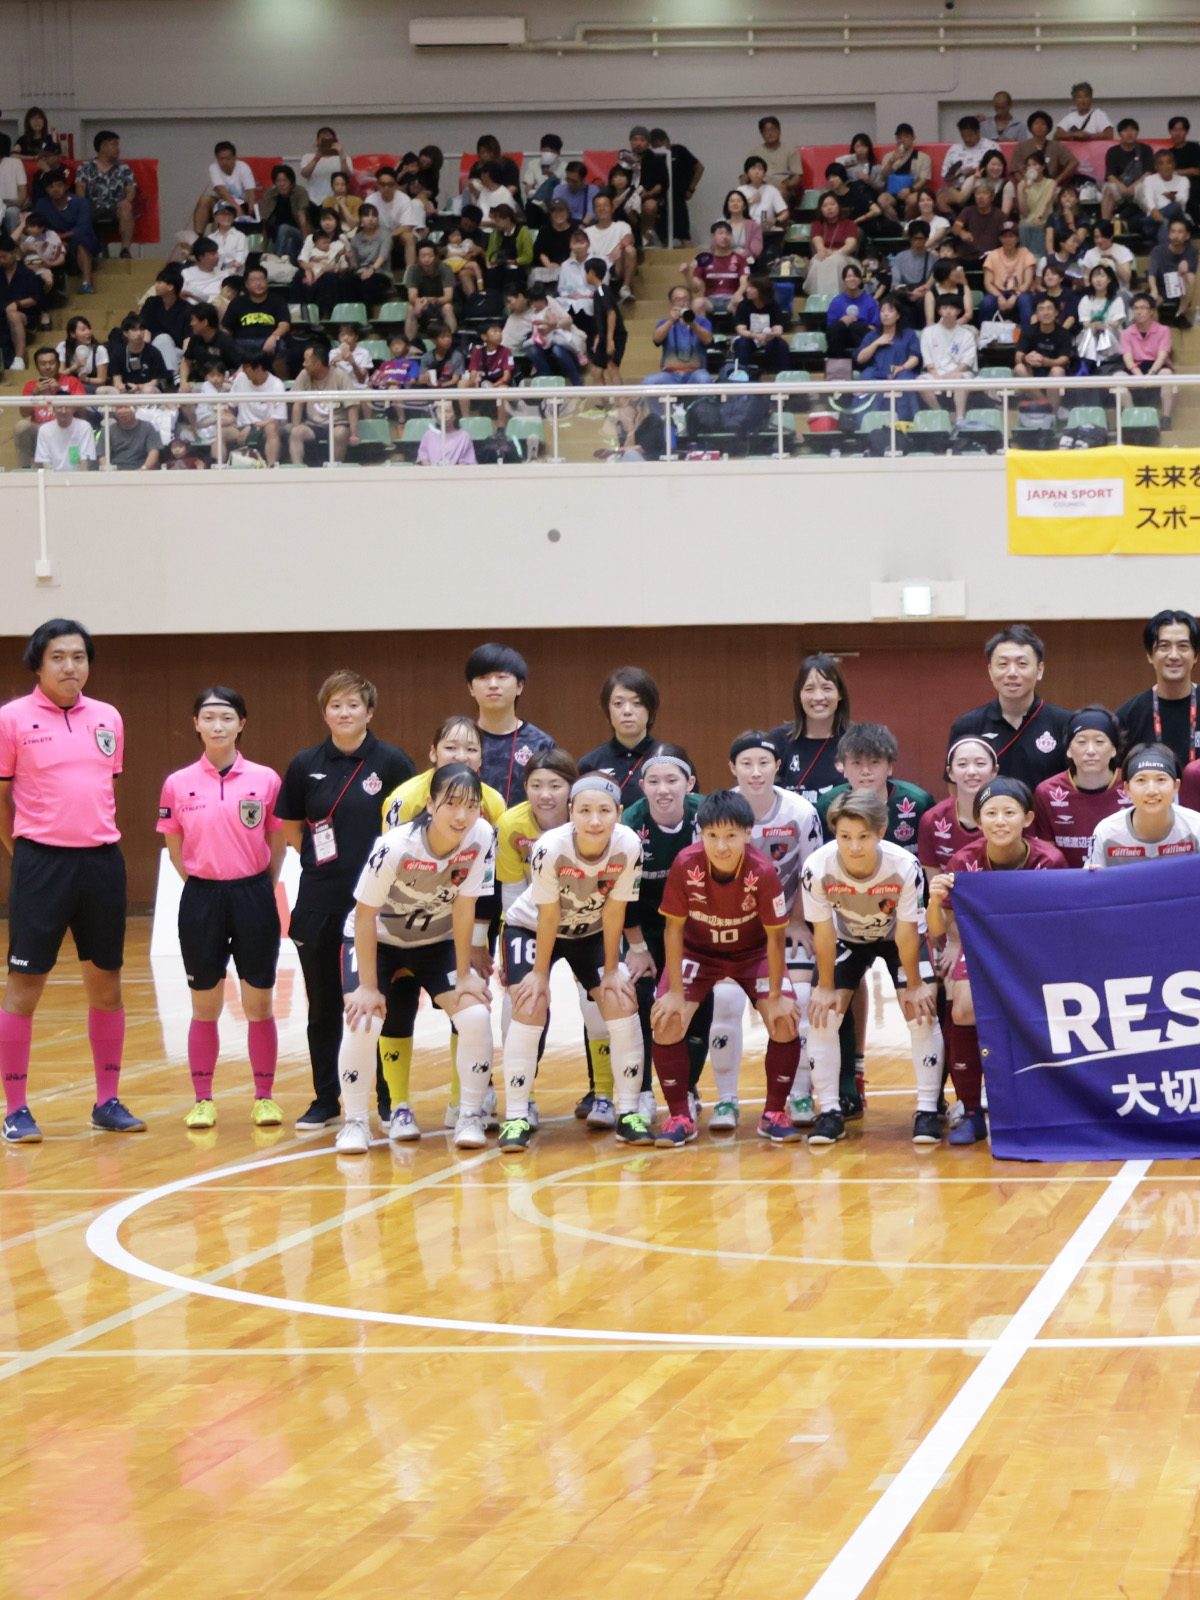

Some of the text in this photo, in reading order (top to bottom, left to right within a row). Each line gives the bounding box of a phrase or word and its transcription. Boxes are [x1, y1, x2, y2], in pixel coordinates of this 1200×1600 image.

[1027, 488, 1113, 501] JAPAN SPORT
[405, 908, 434, 932] 11
[710, 929, 739, 944] 10
[511, 936, 537, 965] 18
